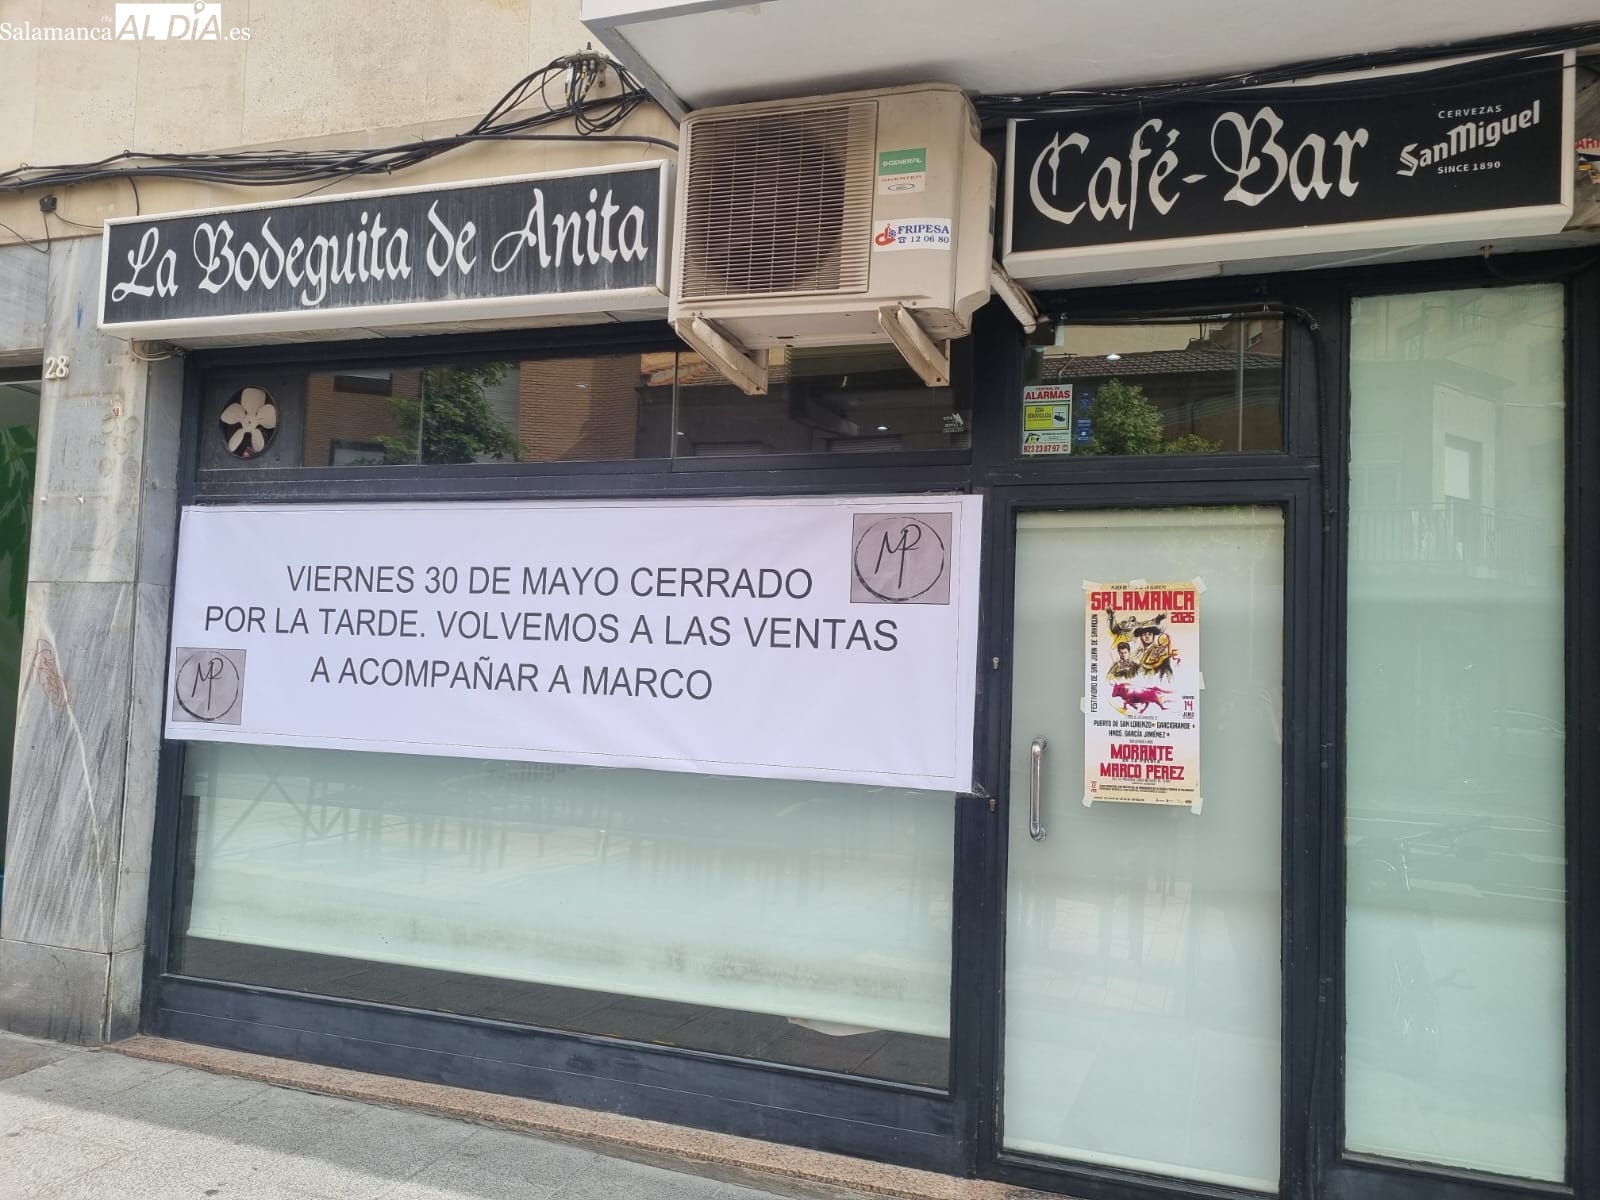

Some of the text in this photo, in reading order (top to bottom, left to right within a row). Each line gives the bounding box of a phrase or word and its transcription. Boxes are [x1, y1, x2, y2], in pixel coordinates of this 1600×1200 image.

[1437, 104, 1503, 119] CERVEZAS
[1437, 161, 1501, 175] SINCE 1890
[897, 224, 950, 235] FRIPESA
[112, 188, 649, 306] La Bodeguita de Anita
[911, 235, 921, 243] 12
[923, 235, 935, 243] 06
[45, 355, 70, 379] 28
[1025, 390, 1071, 400] ALARMAS
[287, 565, 813, 599] VIERNES 30 DE MAYO CERRADO
[1091, 590, 1195, 610] SALAMANCA
[204, 605, 899, 651] POR LA TARDE. VOLVEMOS A LAS VENTAS
[310, 655, 713, 700] A ACOMPAÑAR A MARCO
[1110, 744, 1174, 761] MORANTE
[1100, 763, 1185, 780] MARCO PEREZ
